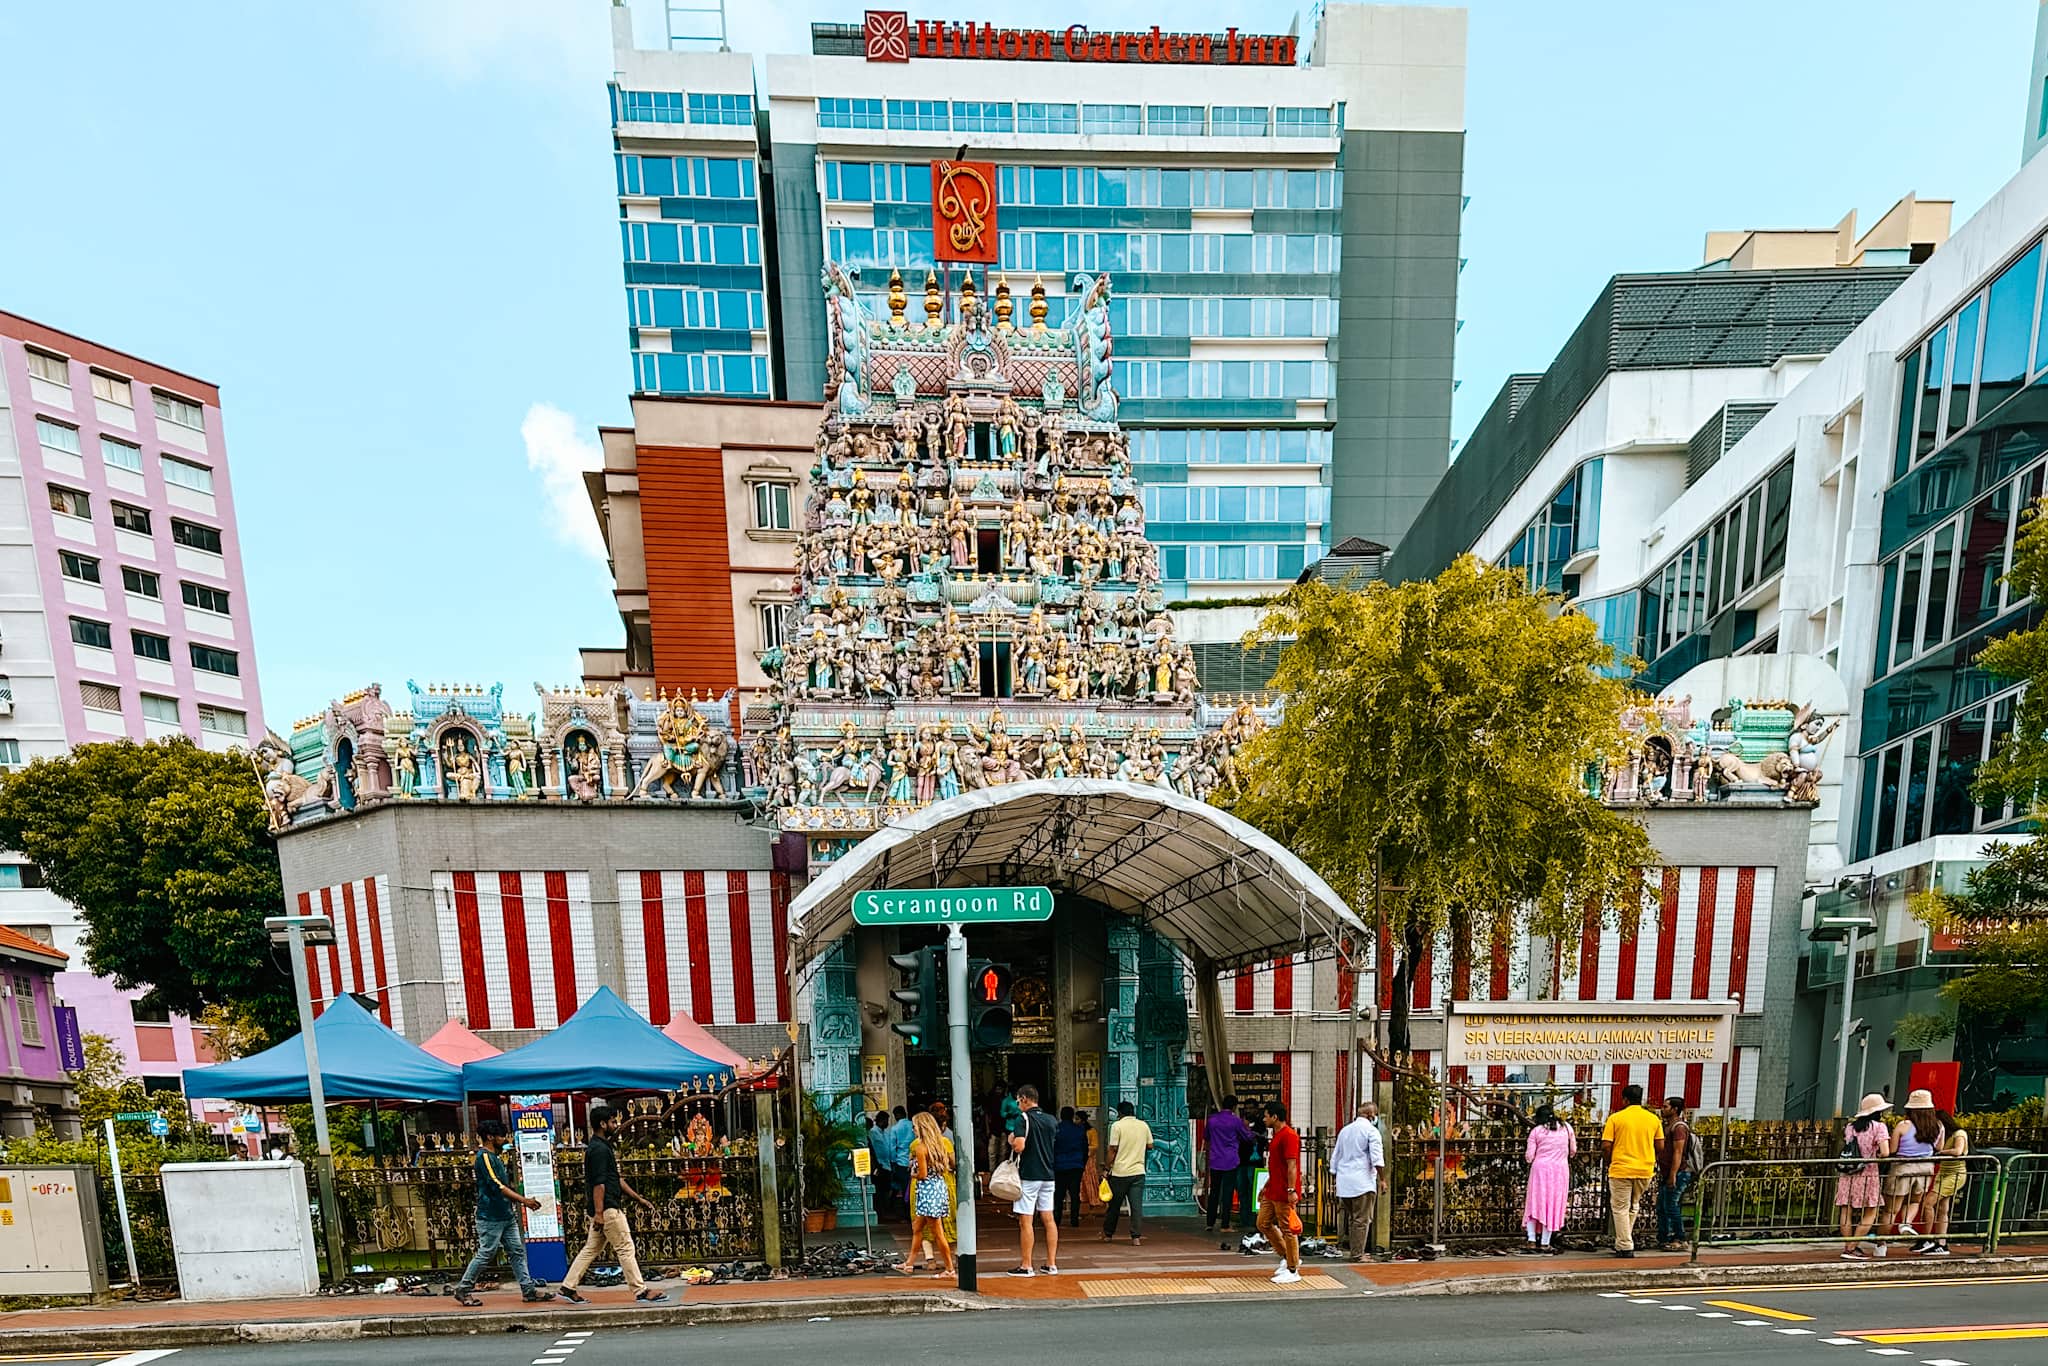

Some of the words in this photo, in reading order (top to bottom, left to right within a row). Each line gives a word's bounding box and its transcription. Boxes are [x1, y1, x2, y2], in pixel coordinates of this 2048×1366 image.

[914, 19, 1054, 60] Hilton
[1063, 23, 1214, 63] Garden
[1226, 27, 1296, 65] Inn
[867, 894, 998, 918] Serangoon
[1013, 891, 1041, 911] Rd
[1465, 1030, 1489, 1044] SRI
[1494, 1029, 1655, 1044] VEERAMAKALIAMMAN
[1658, 1029, 1715, 1043] TEMPLE
[1464, 1050, 1482, 1061] 141
[1486, 1048, 1561, 1061] SERANGOON
[1565, 1048, 1601, 1061] ROAD,
[1604, 1047, 1672, 1060] SINGAPORE
[1675, 1047, 1713, 1060] 218042
[517, 1118, 548, 1129] INDIA
